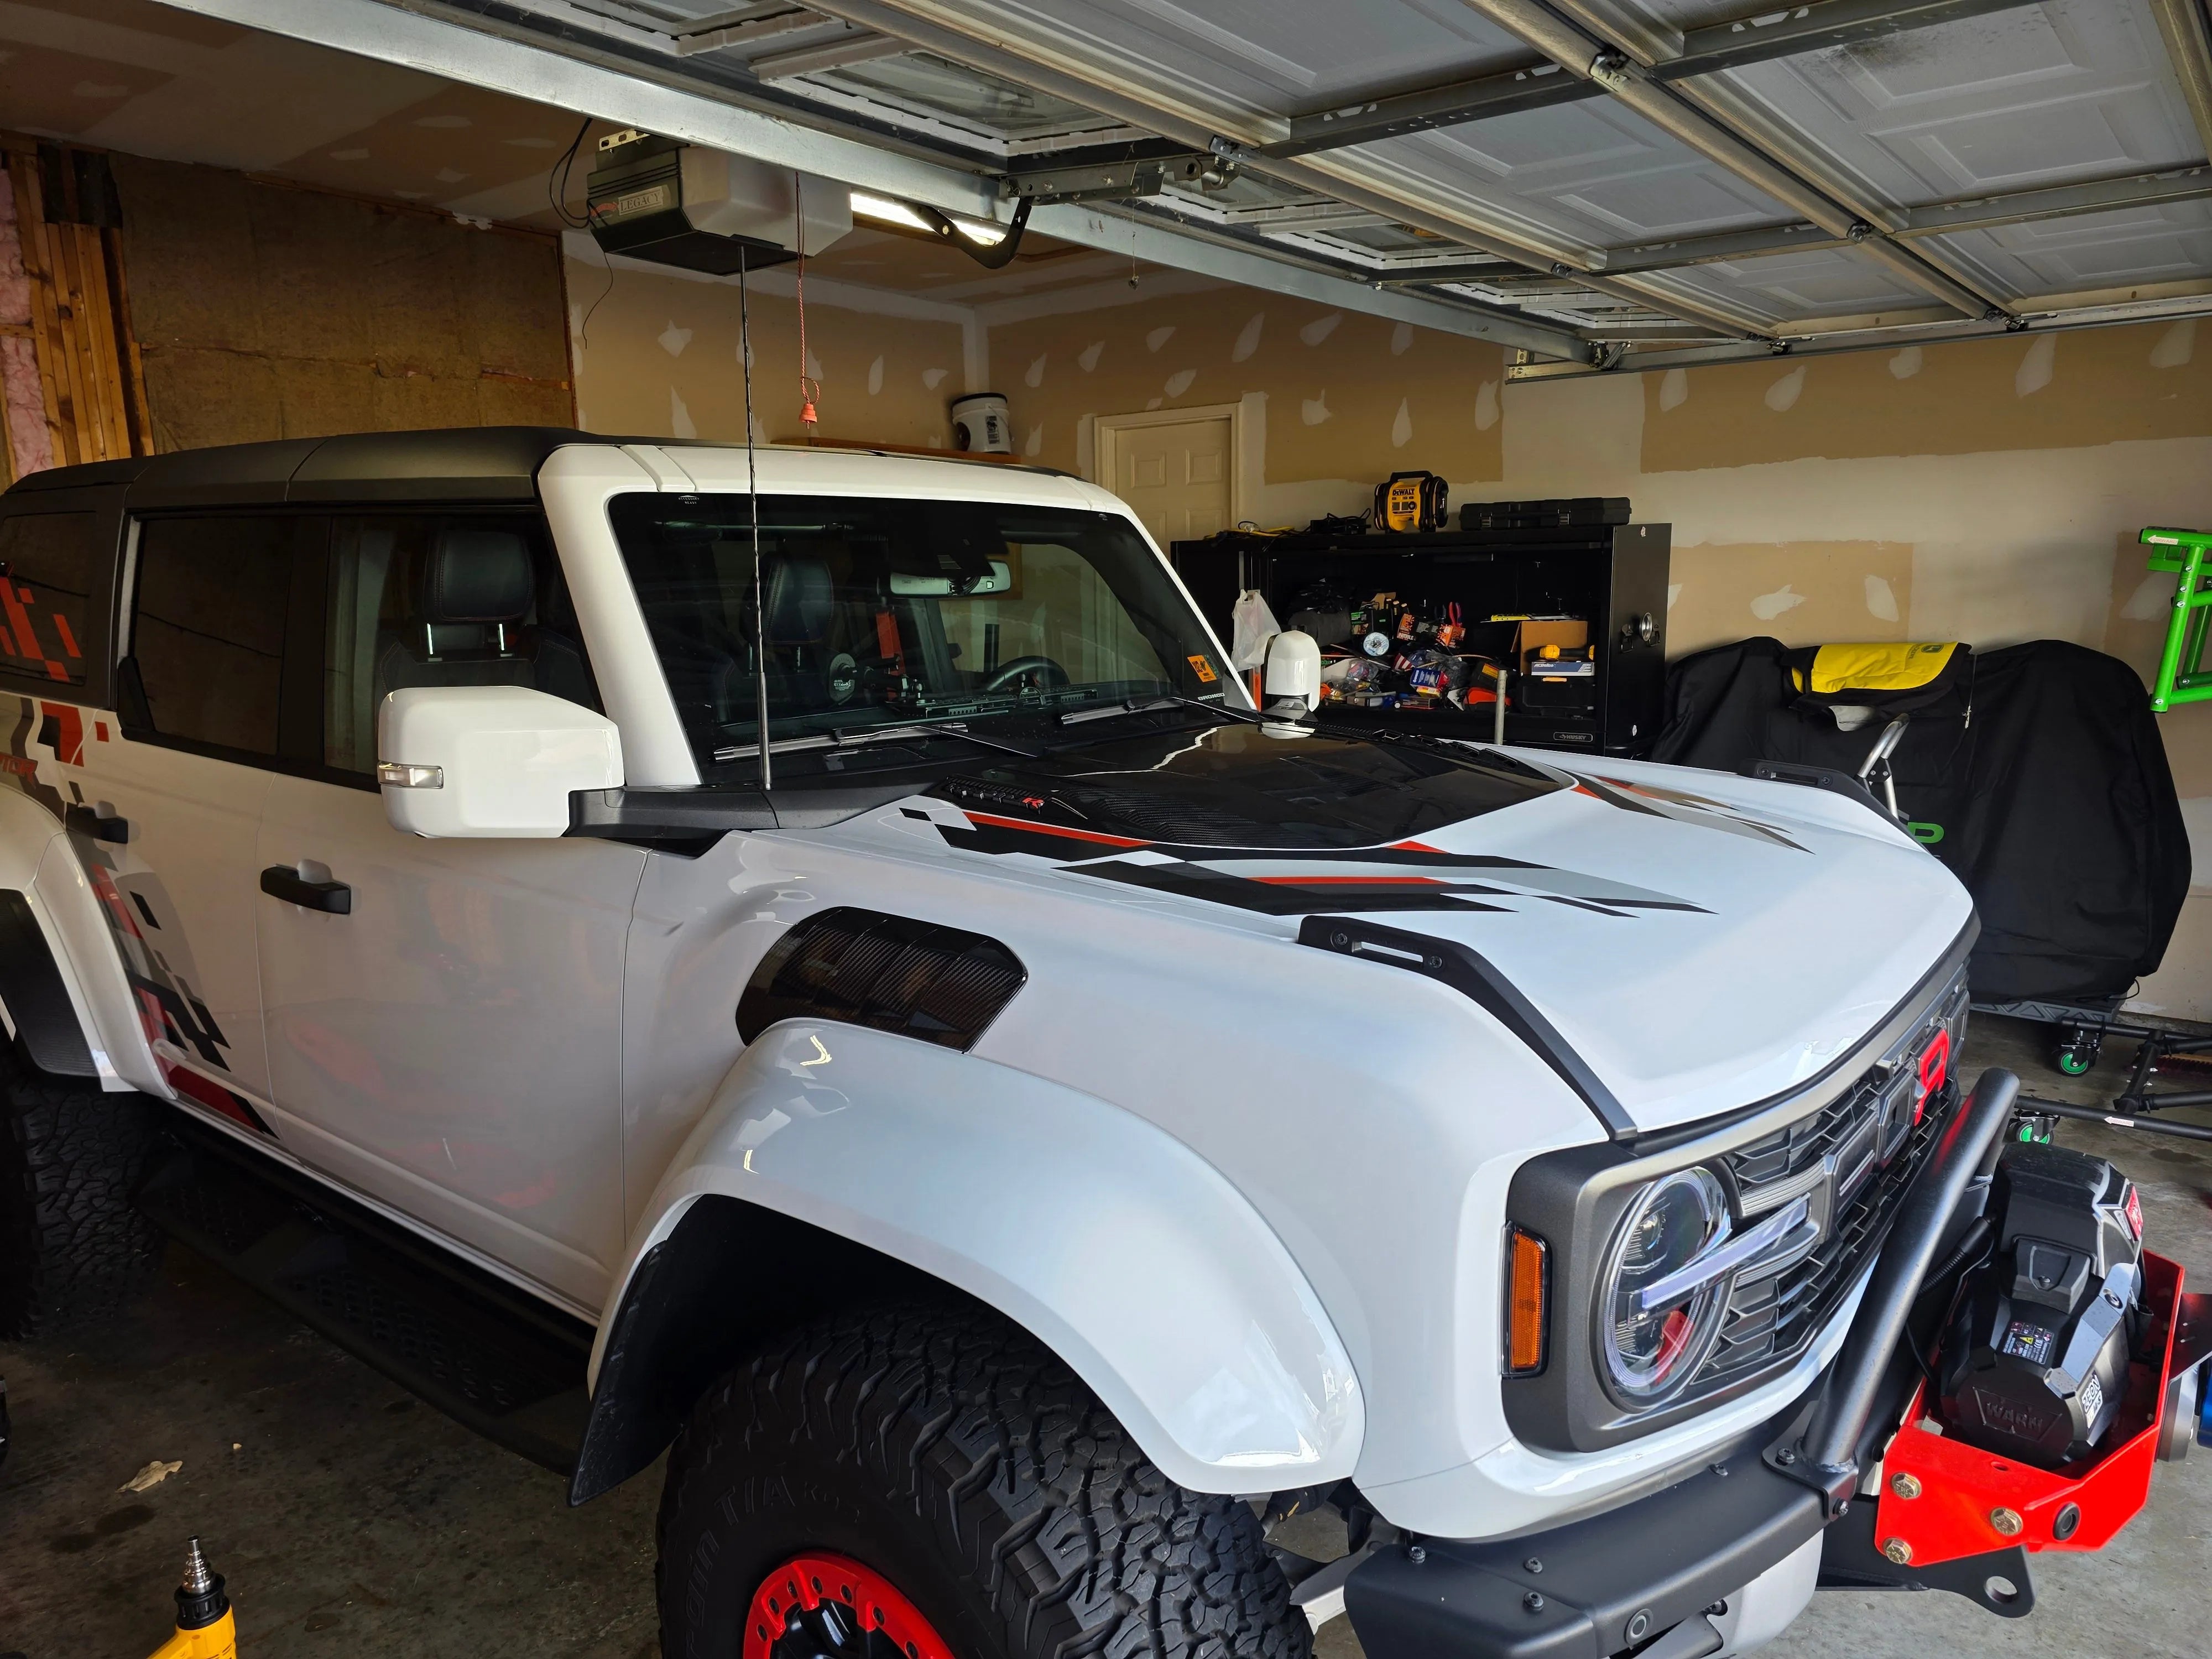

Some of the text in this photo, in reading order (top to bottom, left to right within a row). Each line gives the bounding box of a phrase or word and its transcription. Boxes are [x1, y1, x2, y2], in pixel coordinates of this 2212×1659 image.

[620, 192, 661, 211] LEGACY
[1197, 692, 1225, 701] BRONCO
[2081, 1371, 2101, 1413] ZEON
[1986, 1402, 2043, 1433] WARN
[714, 1475, 796, 1527] T/A
